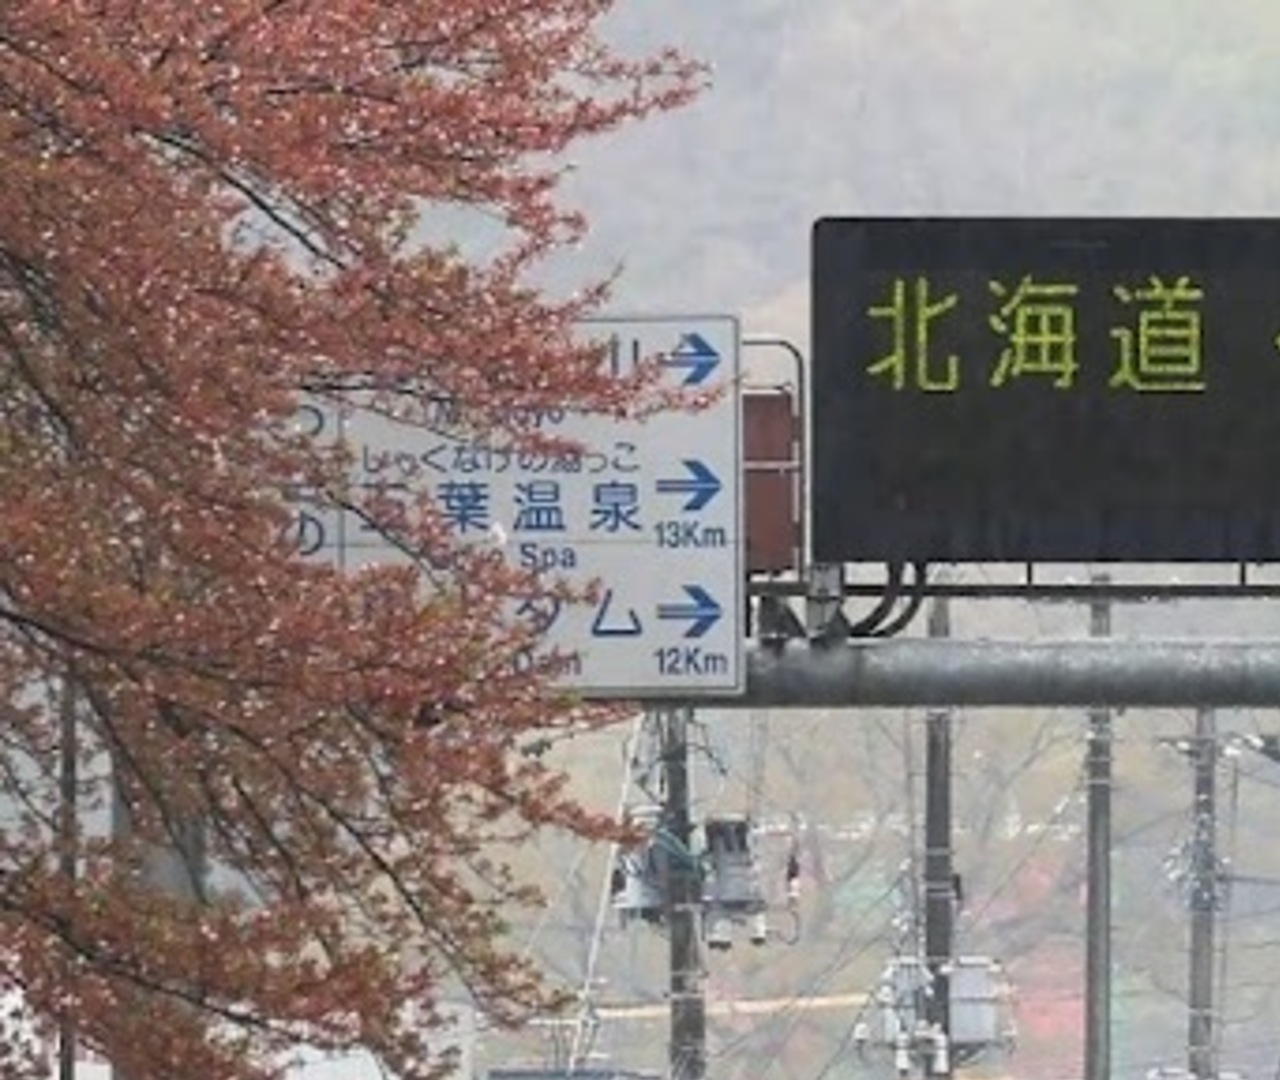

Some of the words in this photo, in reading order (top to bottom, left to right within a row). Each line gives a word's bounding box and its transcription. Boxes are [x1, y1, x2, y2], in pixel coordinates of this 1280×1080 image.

[655, 521, 726, 548] 13Km
[520, 544, 577, 571] Spa
[655, 648, 728, 675] 12Km
